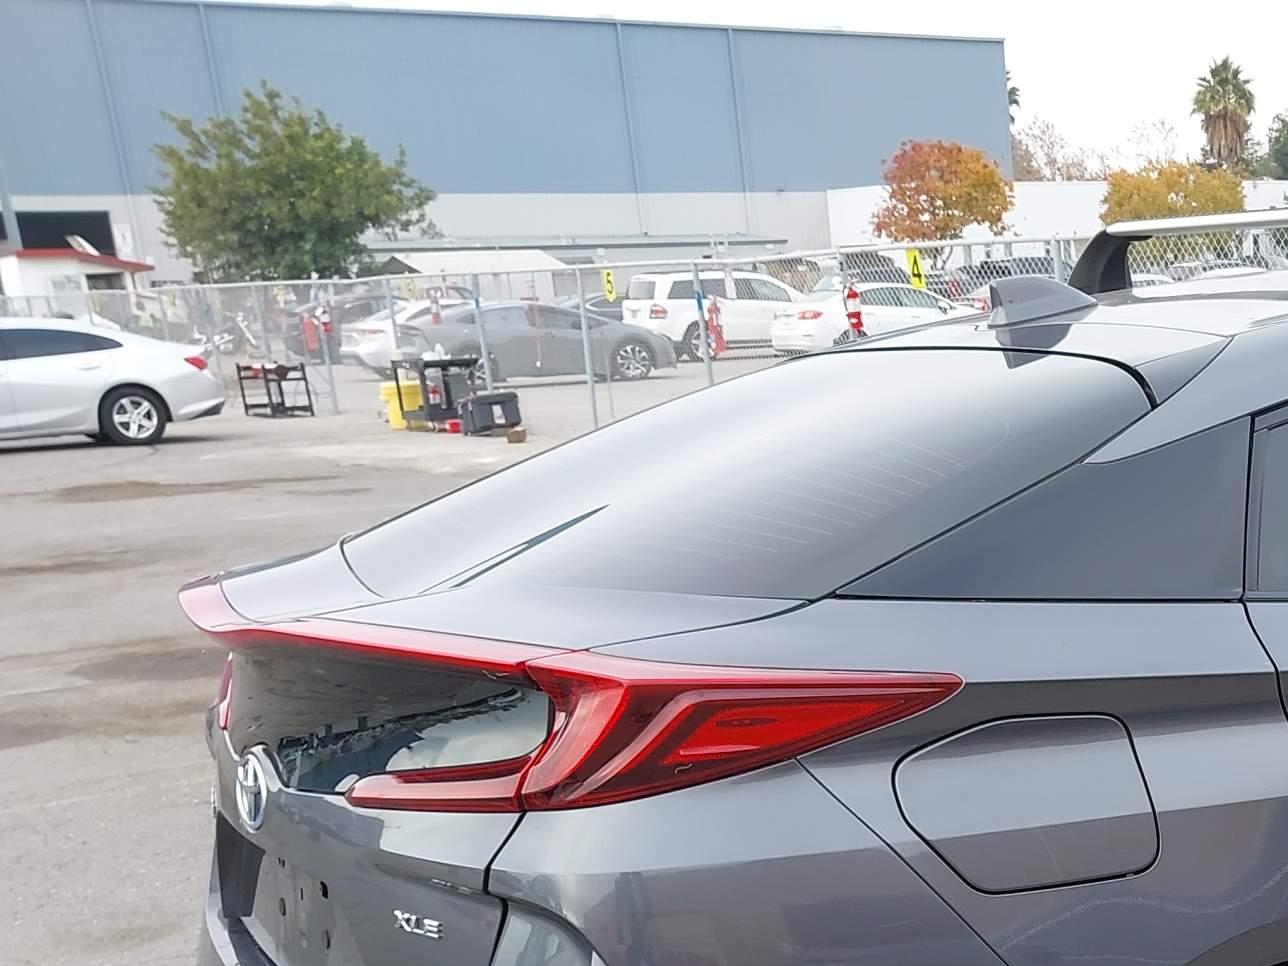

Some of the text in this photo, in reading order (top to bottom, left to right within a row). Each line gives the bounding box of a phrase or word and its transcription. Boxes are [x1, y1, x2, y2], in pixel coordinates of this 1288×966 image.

[605, 271, 614, 295] 5
[911, 254, 922, 284] 4
[393, 909, 442, 938] XLE
